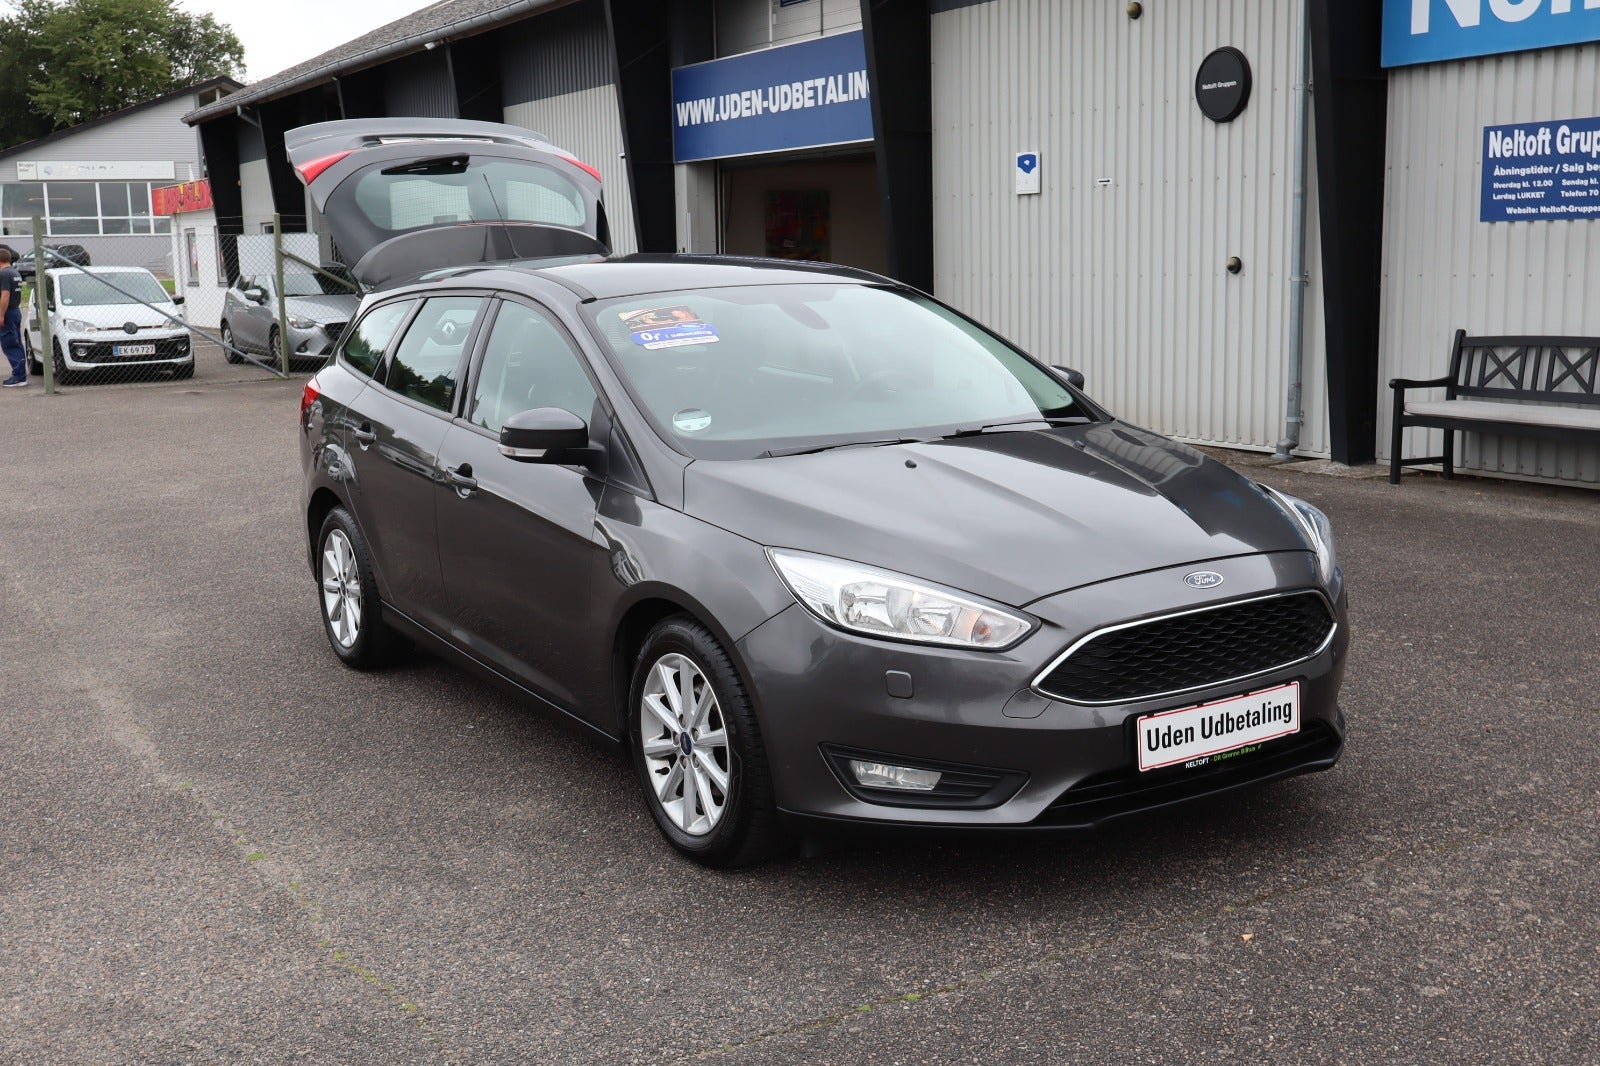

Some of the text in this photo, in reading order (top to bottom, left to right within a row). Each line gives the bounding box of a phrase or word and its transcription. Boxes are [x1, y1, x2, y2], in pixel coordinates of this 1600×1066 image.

[676, 70, 870, 127] WWW.UDEN-UDBETALIN
[1488, 127, 1551, 158] Neltoft
[1493, 165, 1553, 176] Åbningstider
[1562, 163, 1584, 174] Salg
[1586, 162, 1600, 172] be
[1517, 191, 1546, 199] LUKKET
[1560, 190, 1587, 198] Telefon
[1506, 206, 1539, 214] Website:
[1194, 574, 1215, 585] Ford
[1147, 701, 1292, 752] Uden Udbetaling
[1185, 757, 1210, 769] NELTOFT
